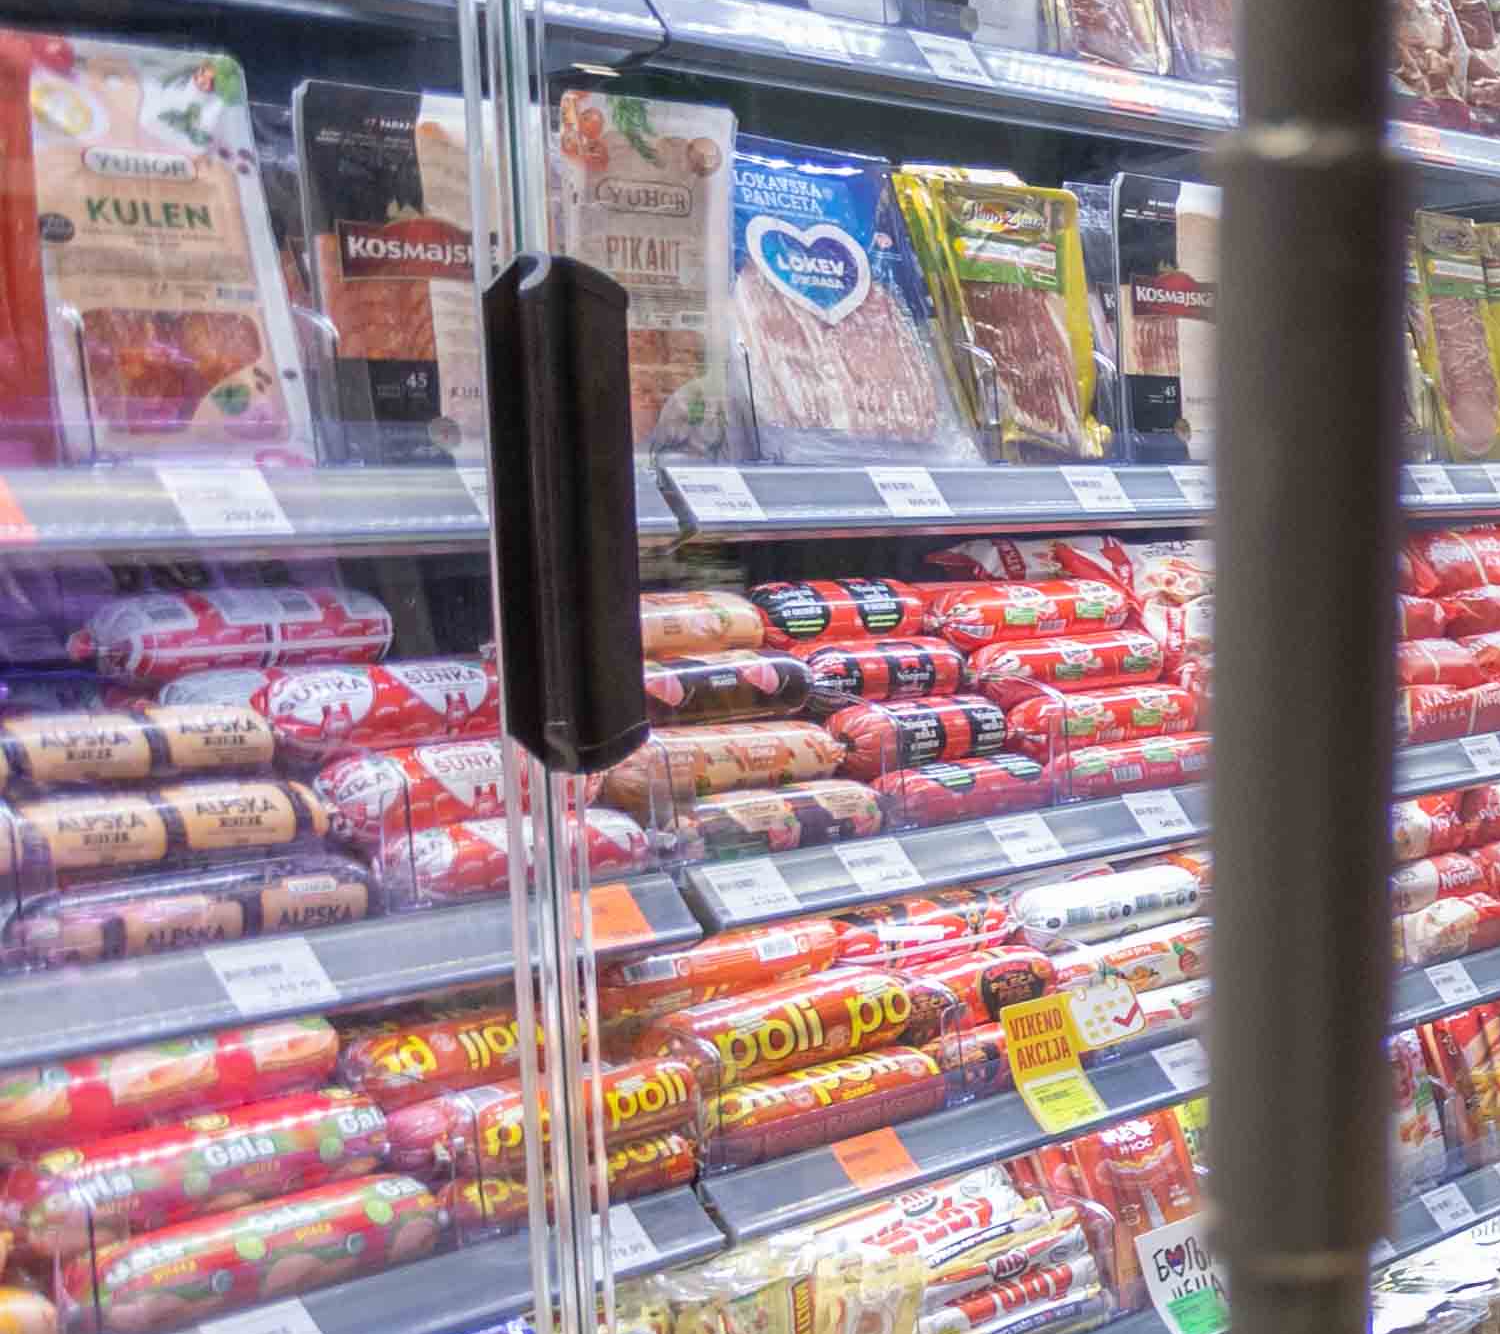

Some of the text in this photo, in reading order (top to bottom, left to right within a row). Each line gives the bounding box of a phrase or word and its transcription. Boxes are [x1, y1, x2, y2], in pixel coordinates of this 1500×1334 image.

[85, 196, 212, 229] KULEN
[714, 997, 825, 1085] poli
[1008, 1006, 1064, 1042] VIKEND
[1015, 1034, 1073, 1072] AKCIJA
[606, 1067, 687, 1131] poli
